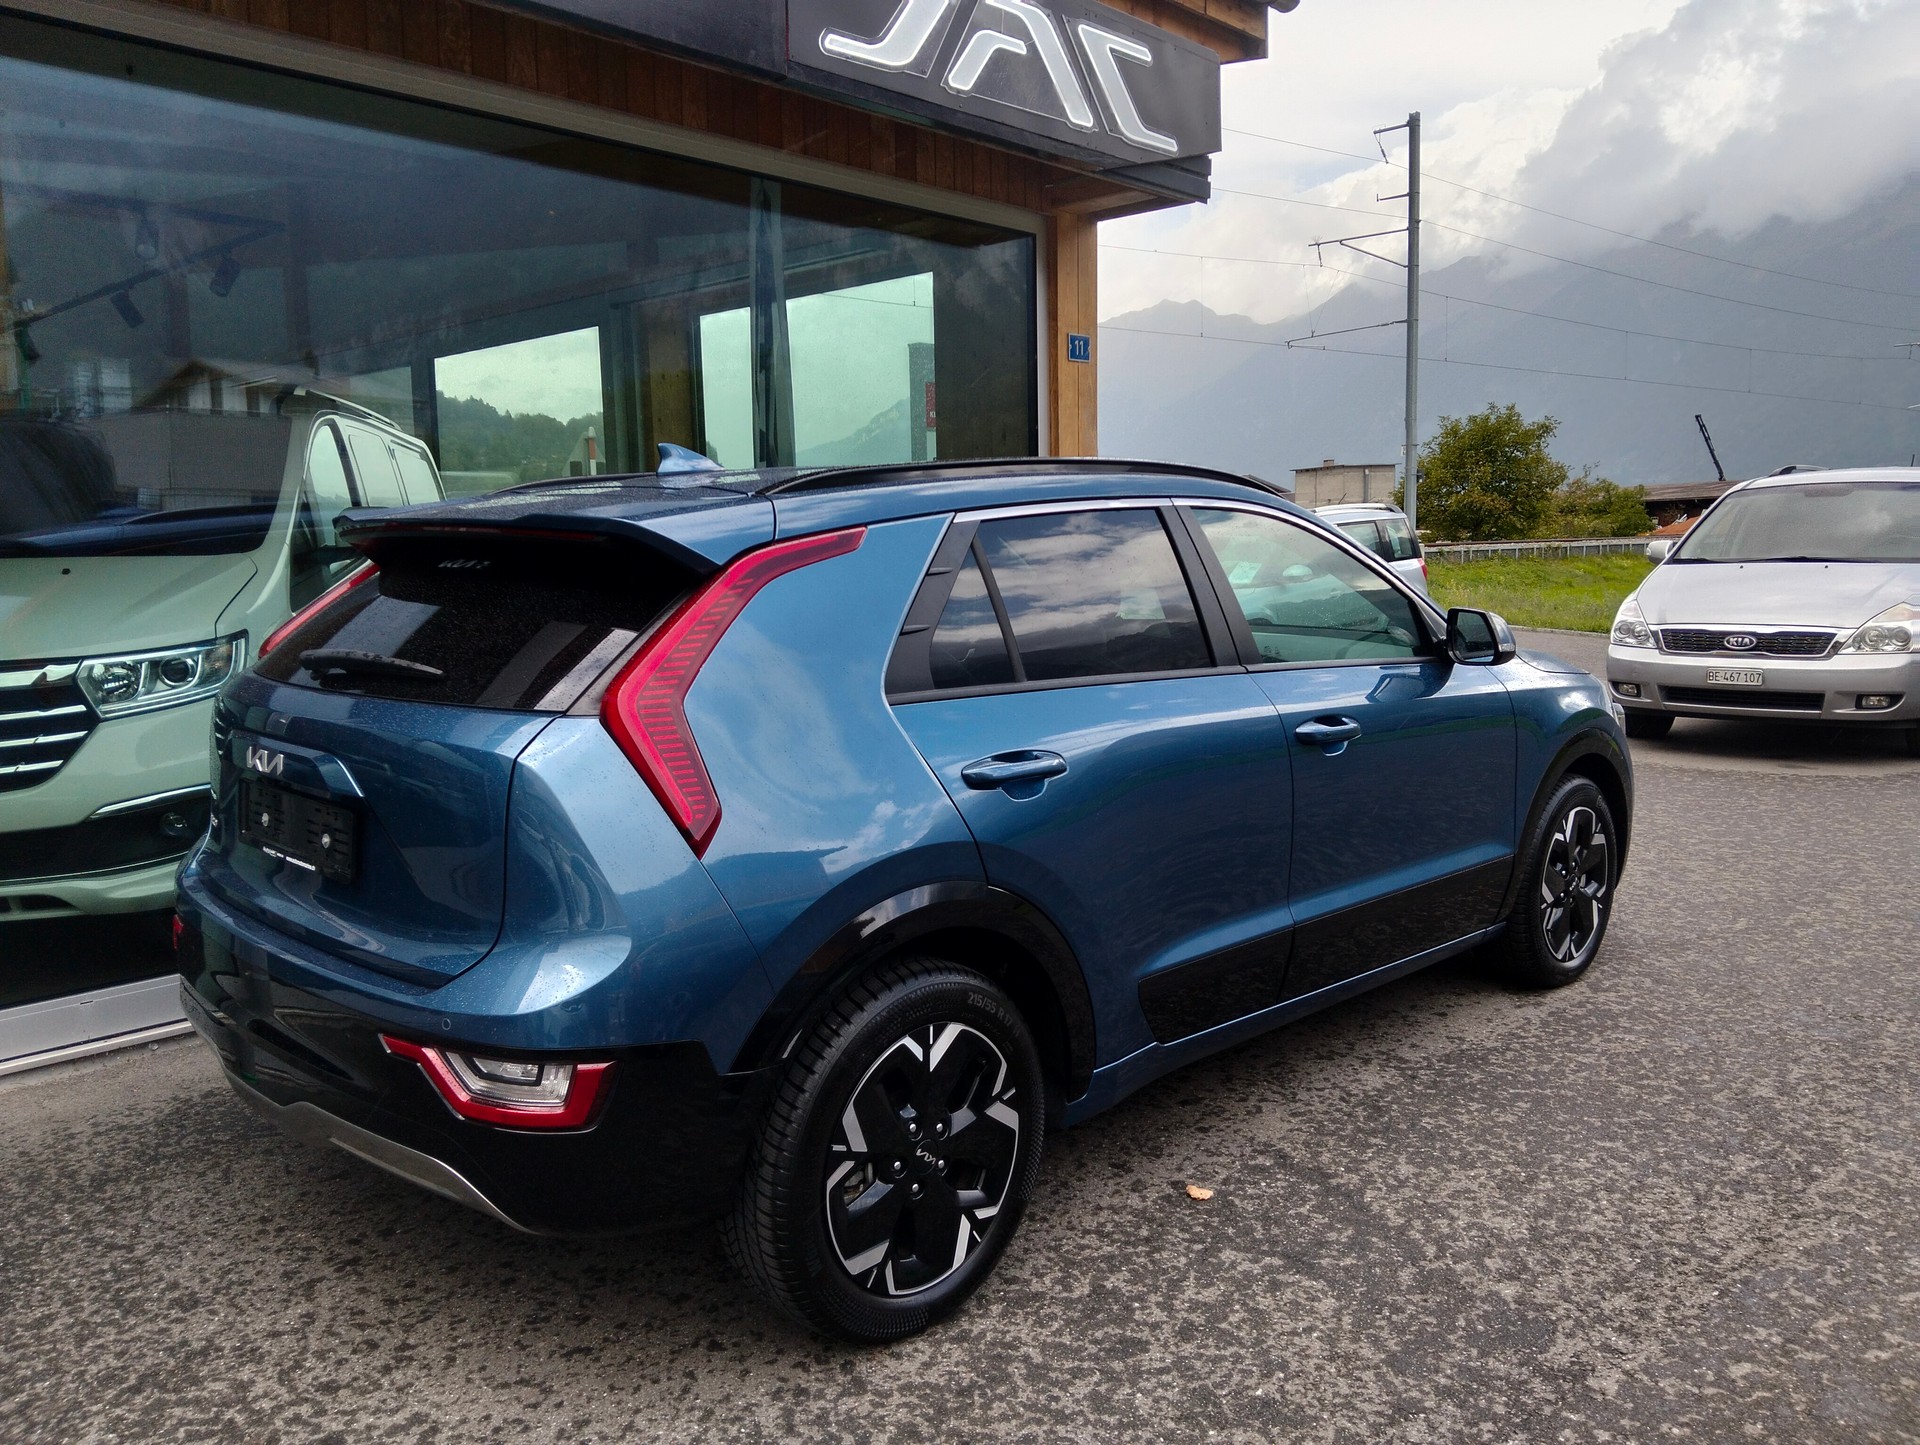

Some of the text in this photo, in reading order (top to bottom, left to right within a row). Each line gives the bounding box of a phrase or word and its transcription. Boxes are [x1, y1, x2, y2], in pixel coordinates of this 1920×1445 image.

[819, 0, 1178, 153] JAC
[1074, 340, 1084, 356] 11
[1728, 637, 1751, 646] KIA
[1744, 672, 1761, 683] 107
[246, 746, 284, 776] KIA
[968, 992, 997, 1014] 215/55
